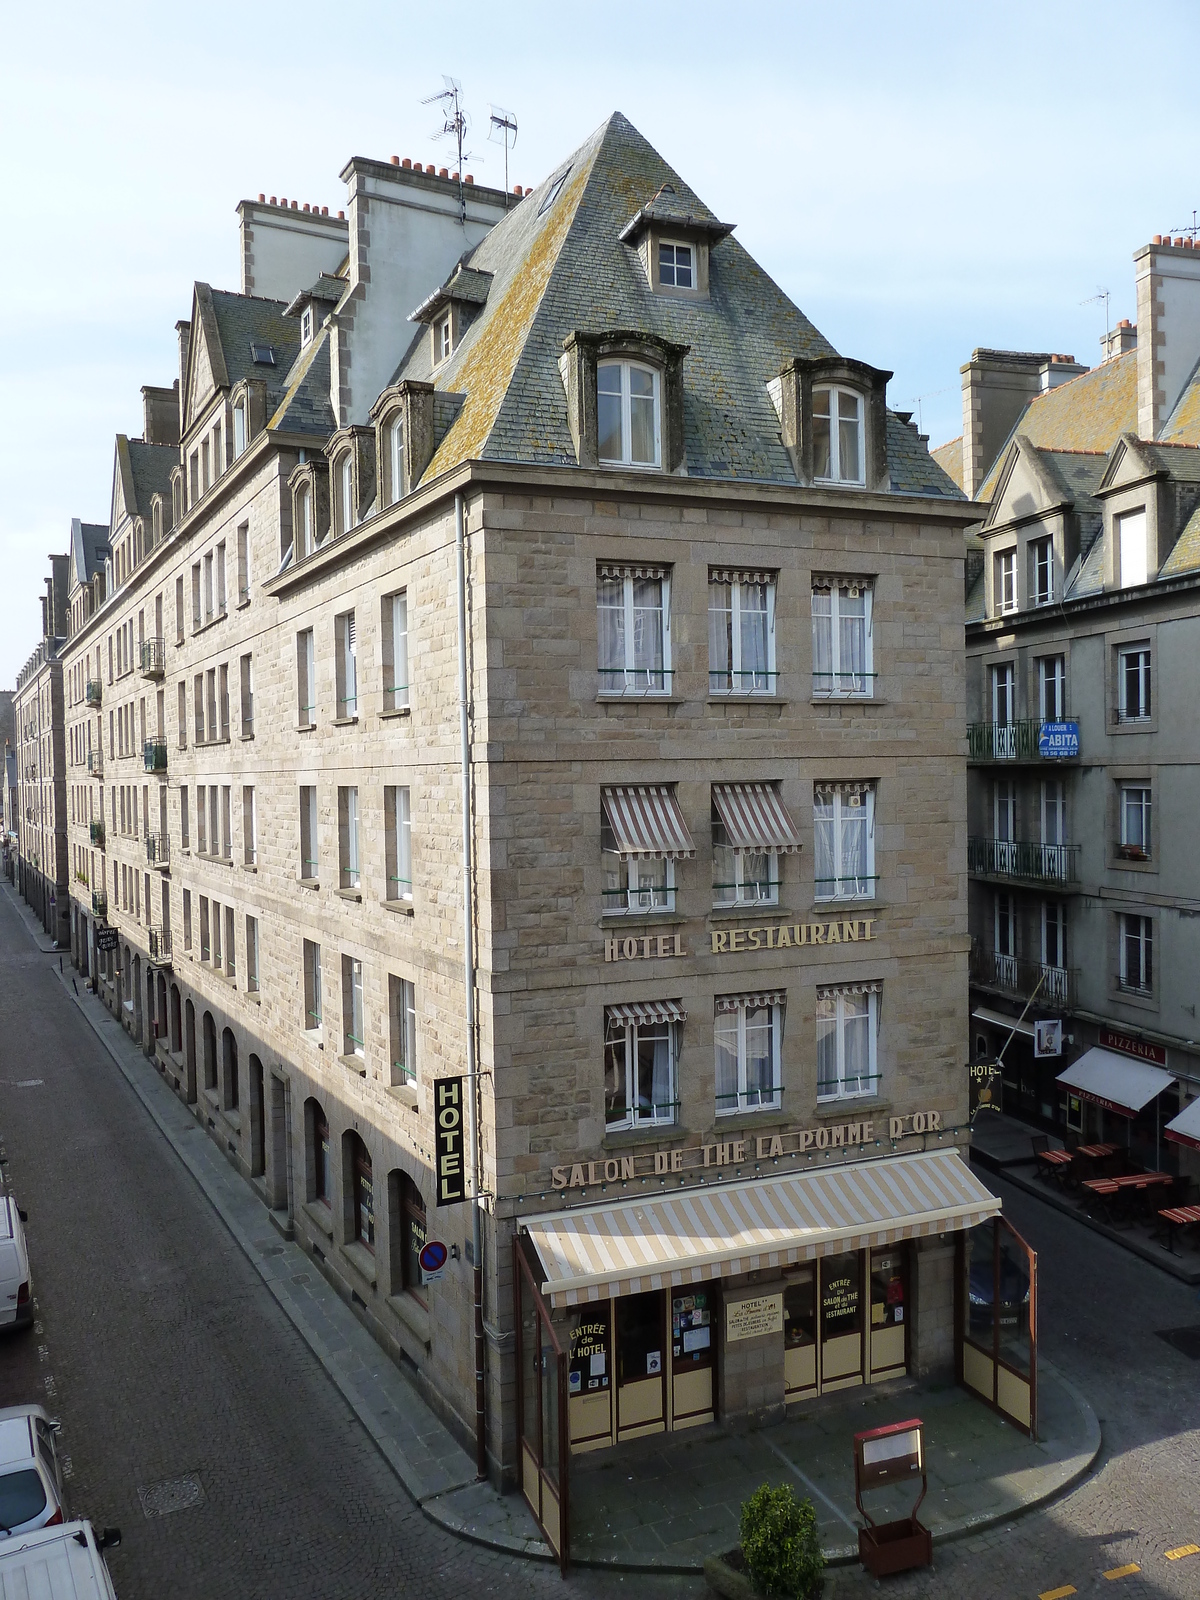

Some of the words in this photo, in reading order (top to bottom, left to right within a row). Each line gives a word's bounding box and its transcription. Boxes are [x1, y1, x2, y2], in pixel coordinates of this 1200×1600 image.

[1048, 734, 1078, 746] ABITA
[604, 933, 687, 962] HOTEL
[709, 918, 877, 954] RESTAURANT
[1108, 1033, 1156, 1059] PIZZERIA
[1078, 1090, 1113, 1109] PIZZERIA
[438, 1083, 461, 1200] HOTEL
[551, 1155, 635, 1190] SALON
[654, 1149, 683, 1176] DE
[701, 1139, 746, 1167] THE
[756, 1134, 784, 1159] LA
[799, 1120, 874, 1153] POMME
[889, 1110, 940, 1139] D'OR
[411, 1221, 425, 1242] SALON
[741, 1300, 762, 1310] HOTEL
[823, 1295, 841, 1306] SALON
[569, 1322, 607, 1341] ENTRÉE
[581, 1335, 594, 1345] de
